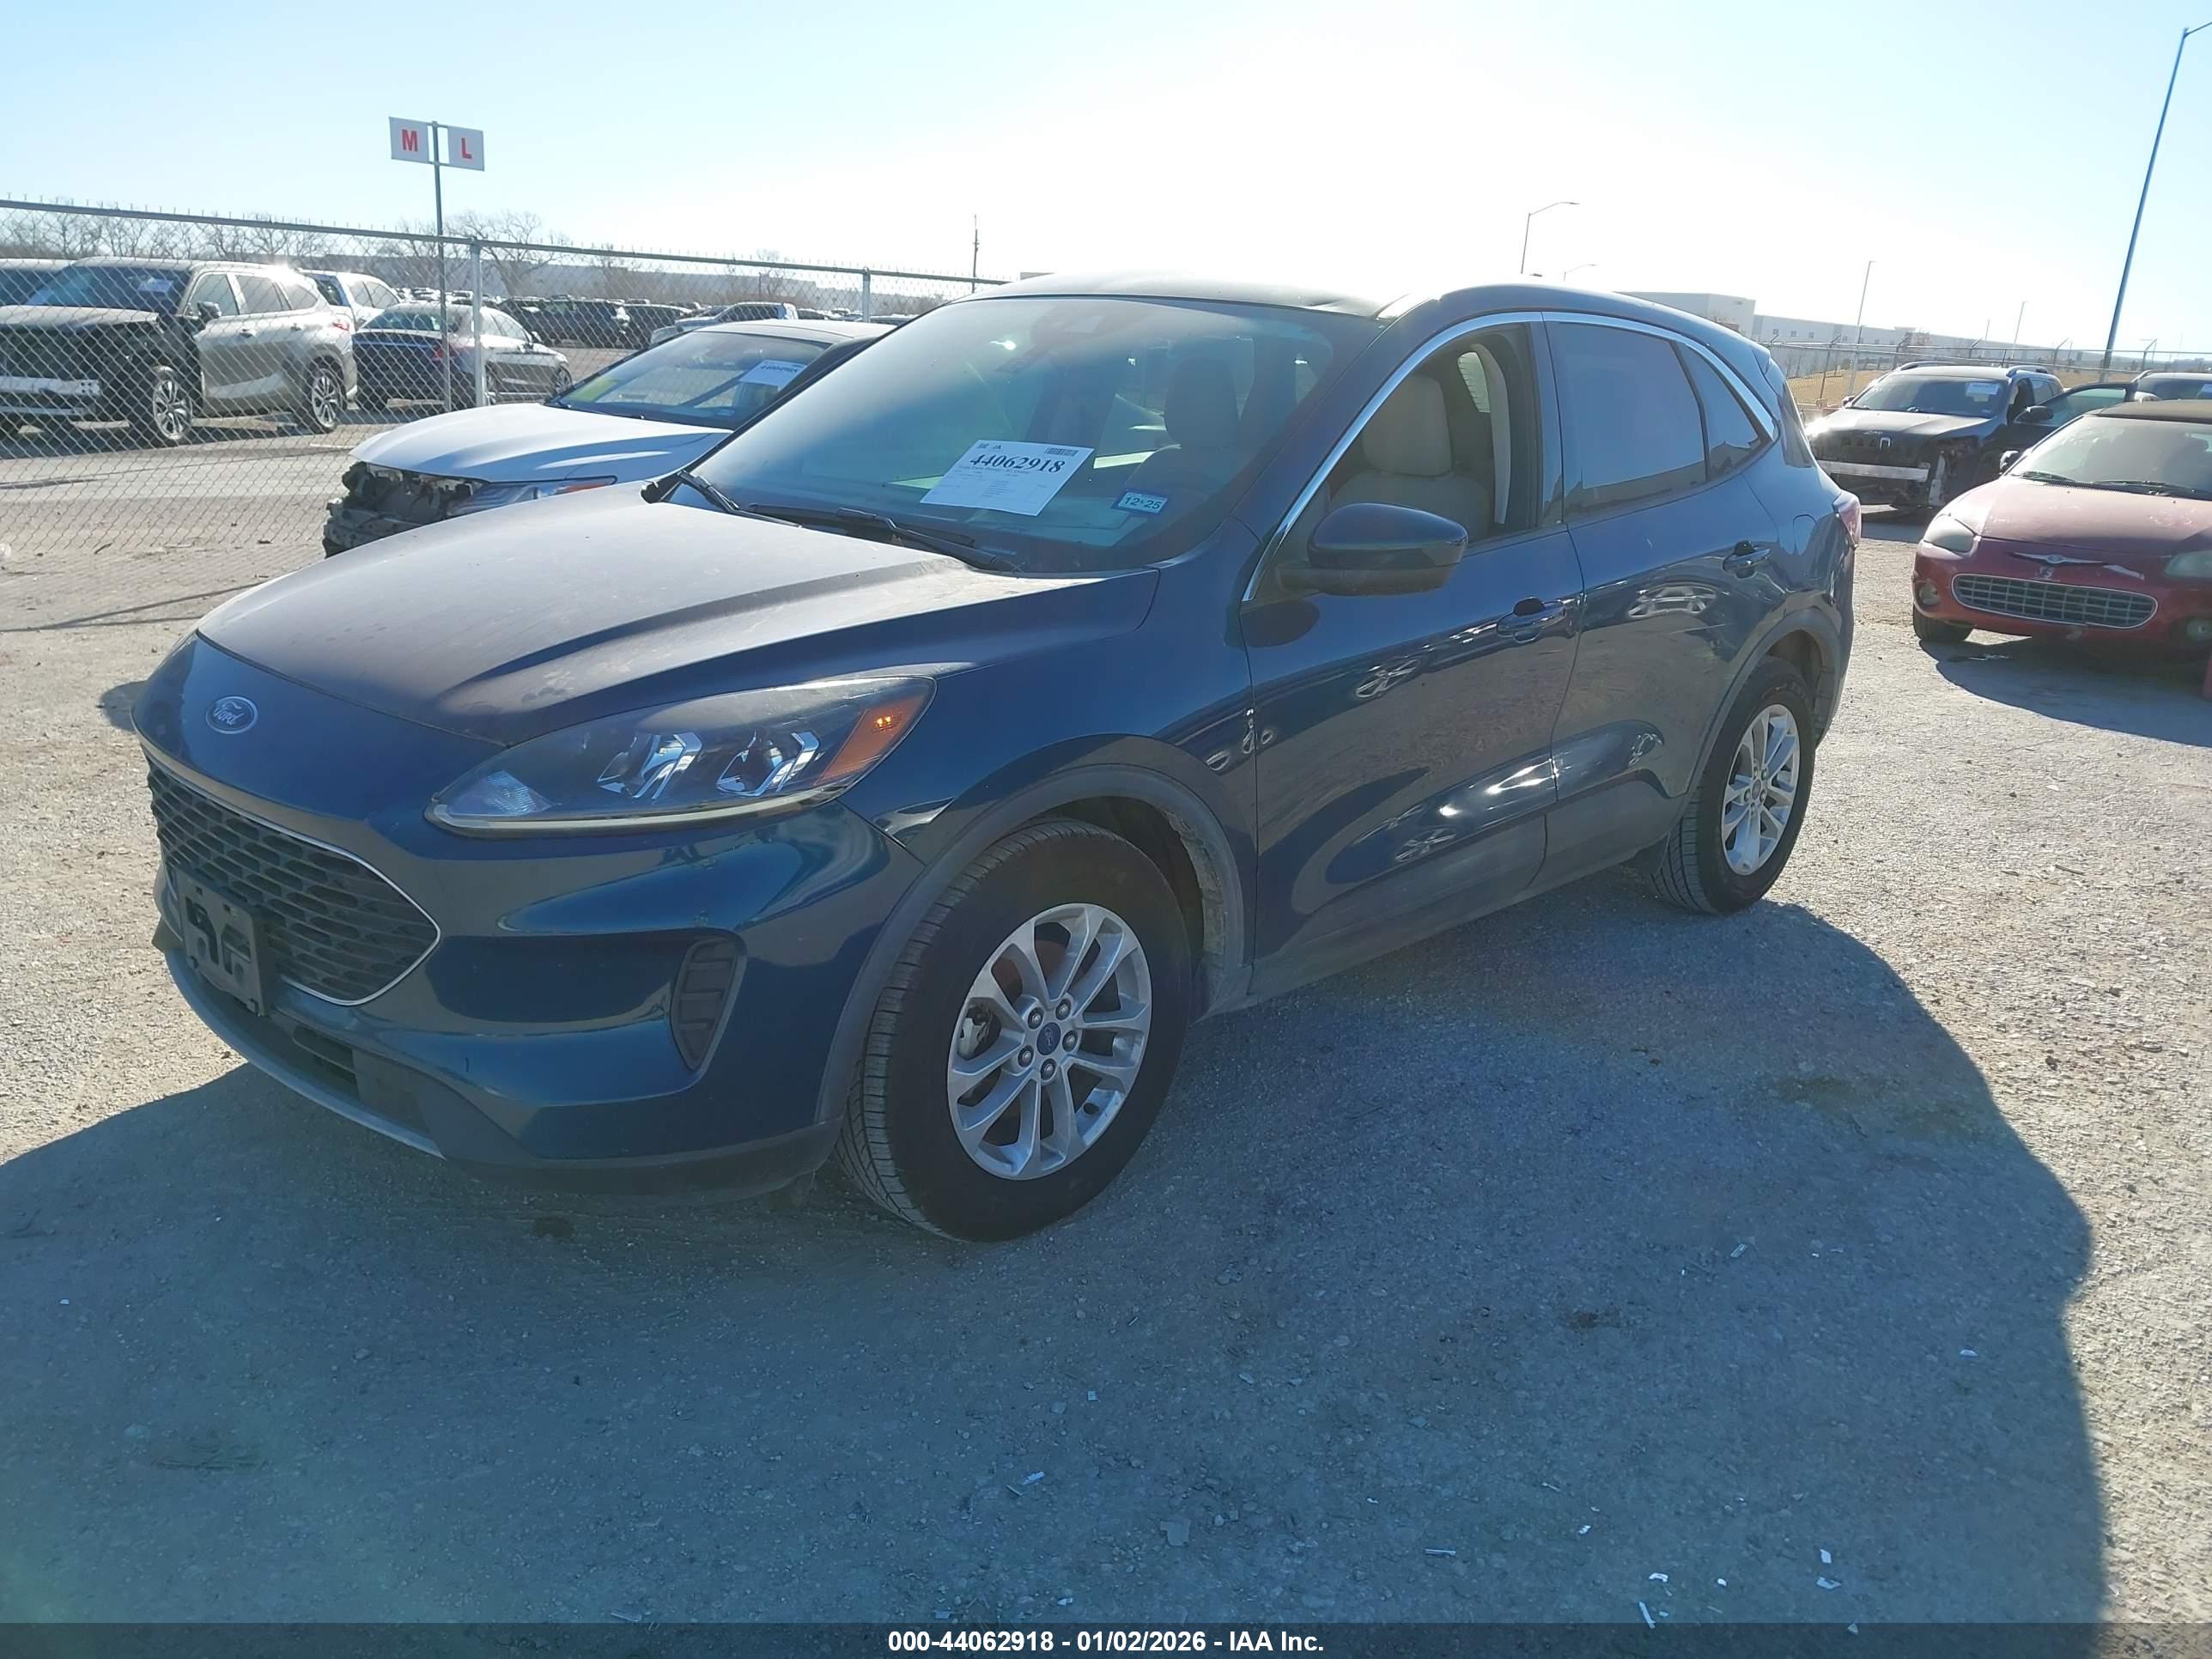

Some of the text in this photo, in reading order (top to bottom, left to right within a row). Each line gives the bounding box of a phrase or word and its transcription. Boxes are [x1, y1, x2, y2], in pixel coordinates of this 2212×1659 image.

[401, 129, 418, 152] M
[461, 137, 473, 160] L
[969, 453, 1066, 474] 44062918
[1143, 500, 1162, 509] 25
